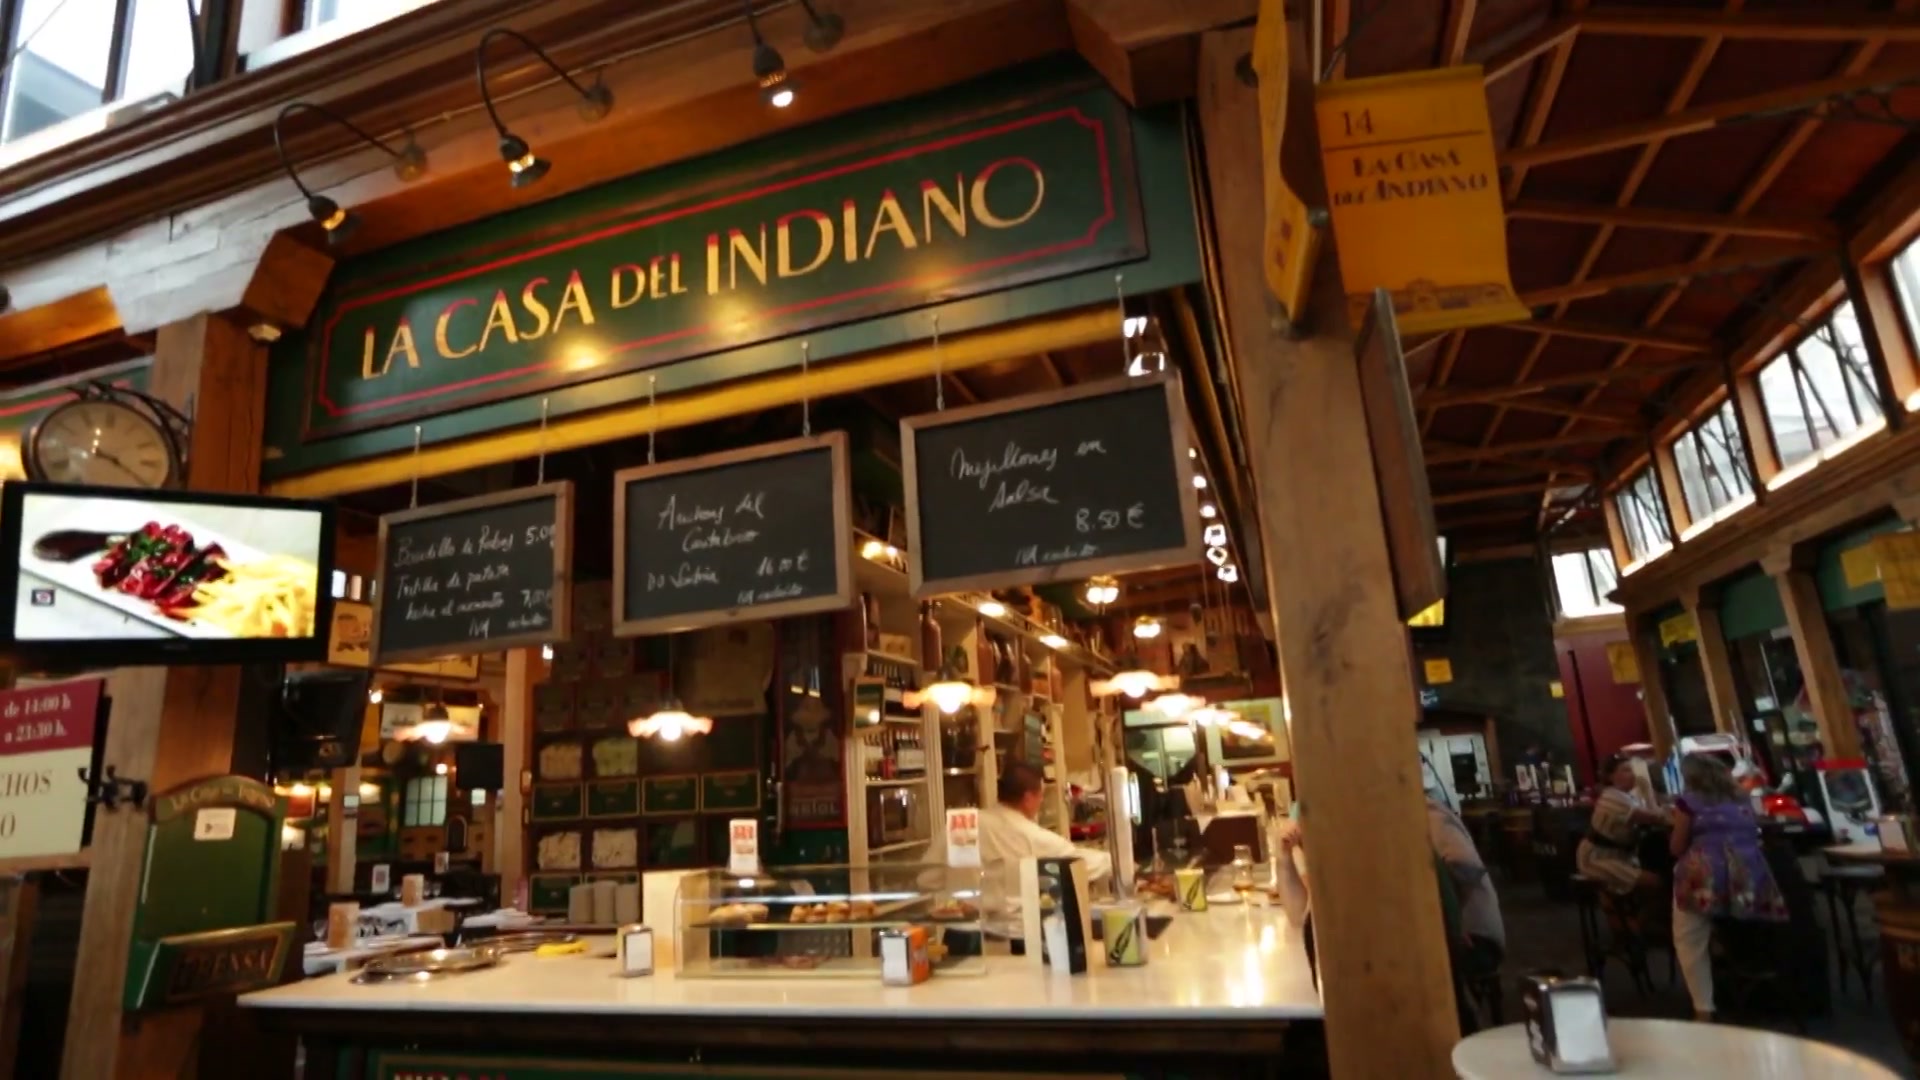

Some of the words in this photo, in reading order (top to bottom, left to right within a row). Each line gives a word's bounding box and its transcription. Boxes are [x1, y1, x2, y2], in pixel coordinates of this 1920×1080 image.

[1342, 108, 1374, 137] 14
[361, 316, 421, 380] LA
[435, 269, 595, 360] CASA
[611, 252, 688, 310] DEL
[706, 156, 1045, 296] INDIANO
